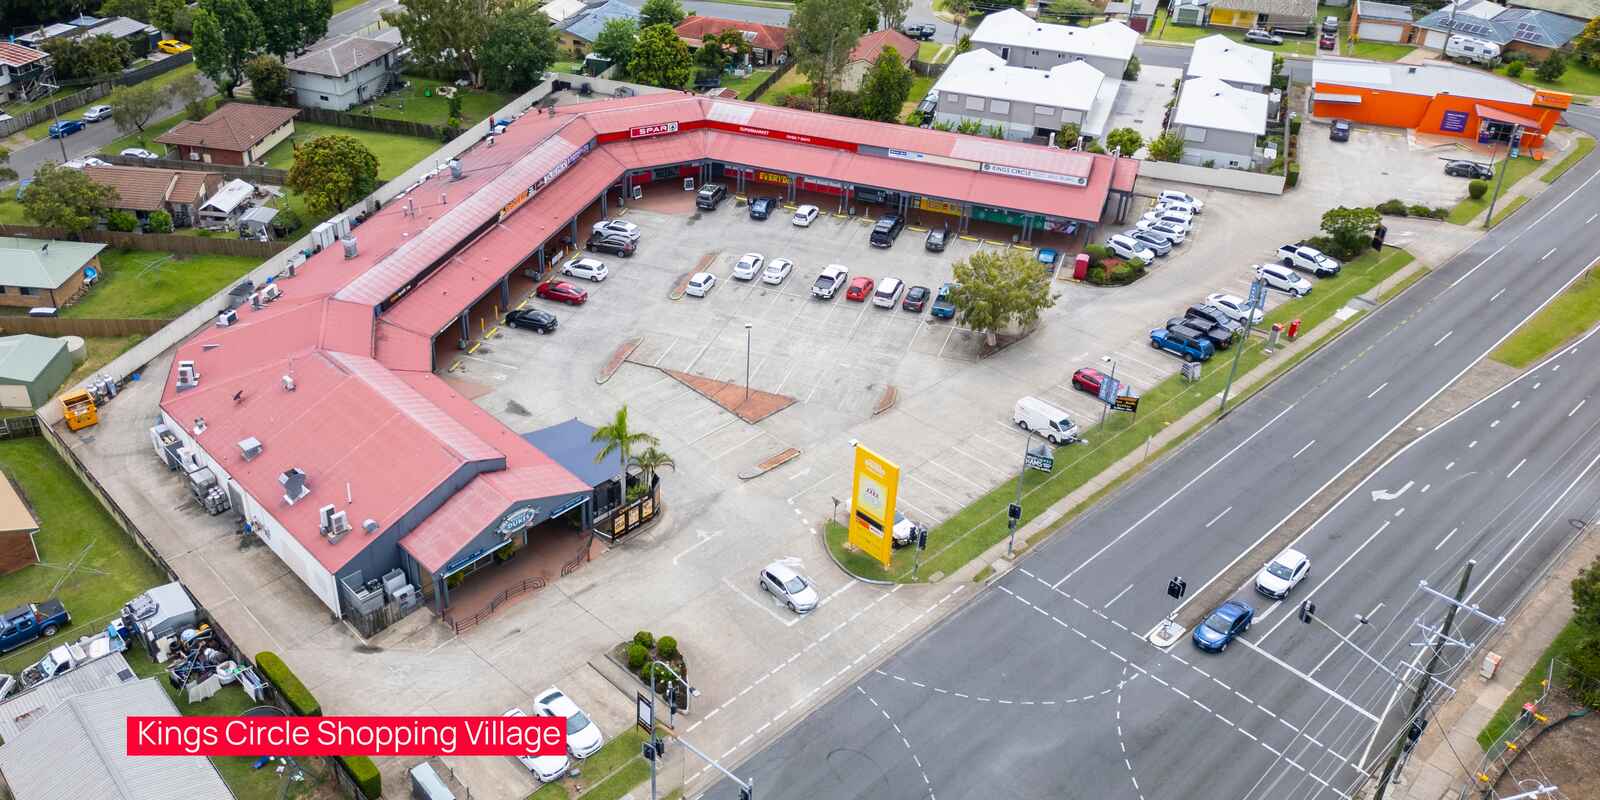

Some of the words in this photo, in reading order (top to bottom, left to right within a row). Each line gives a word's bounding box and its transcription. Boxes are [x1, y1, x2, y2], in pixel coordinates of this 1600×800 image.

[639, 125, 667, 135] SPAR
[991, 165, 1010, 173] KINGS
[1011, 168, 1032, 177] CIRCLE
